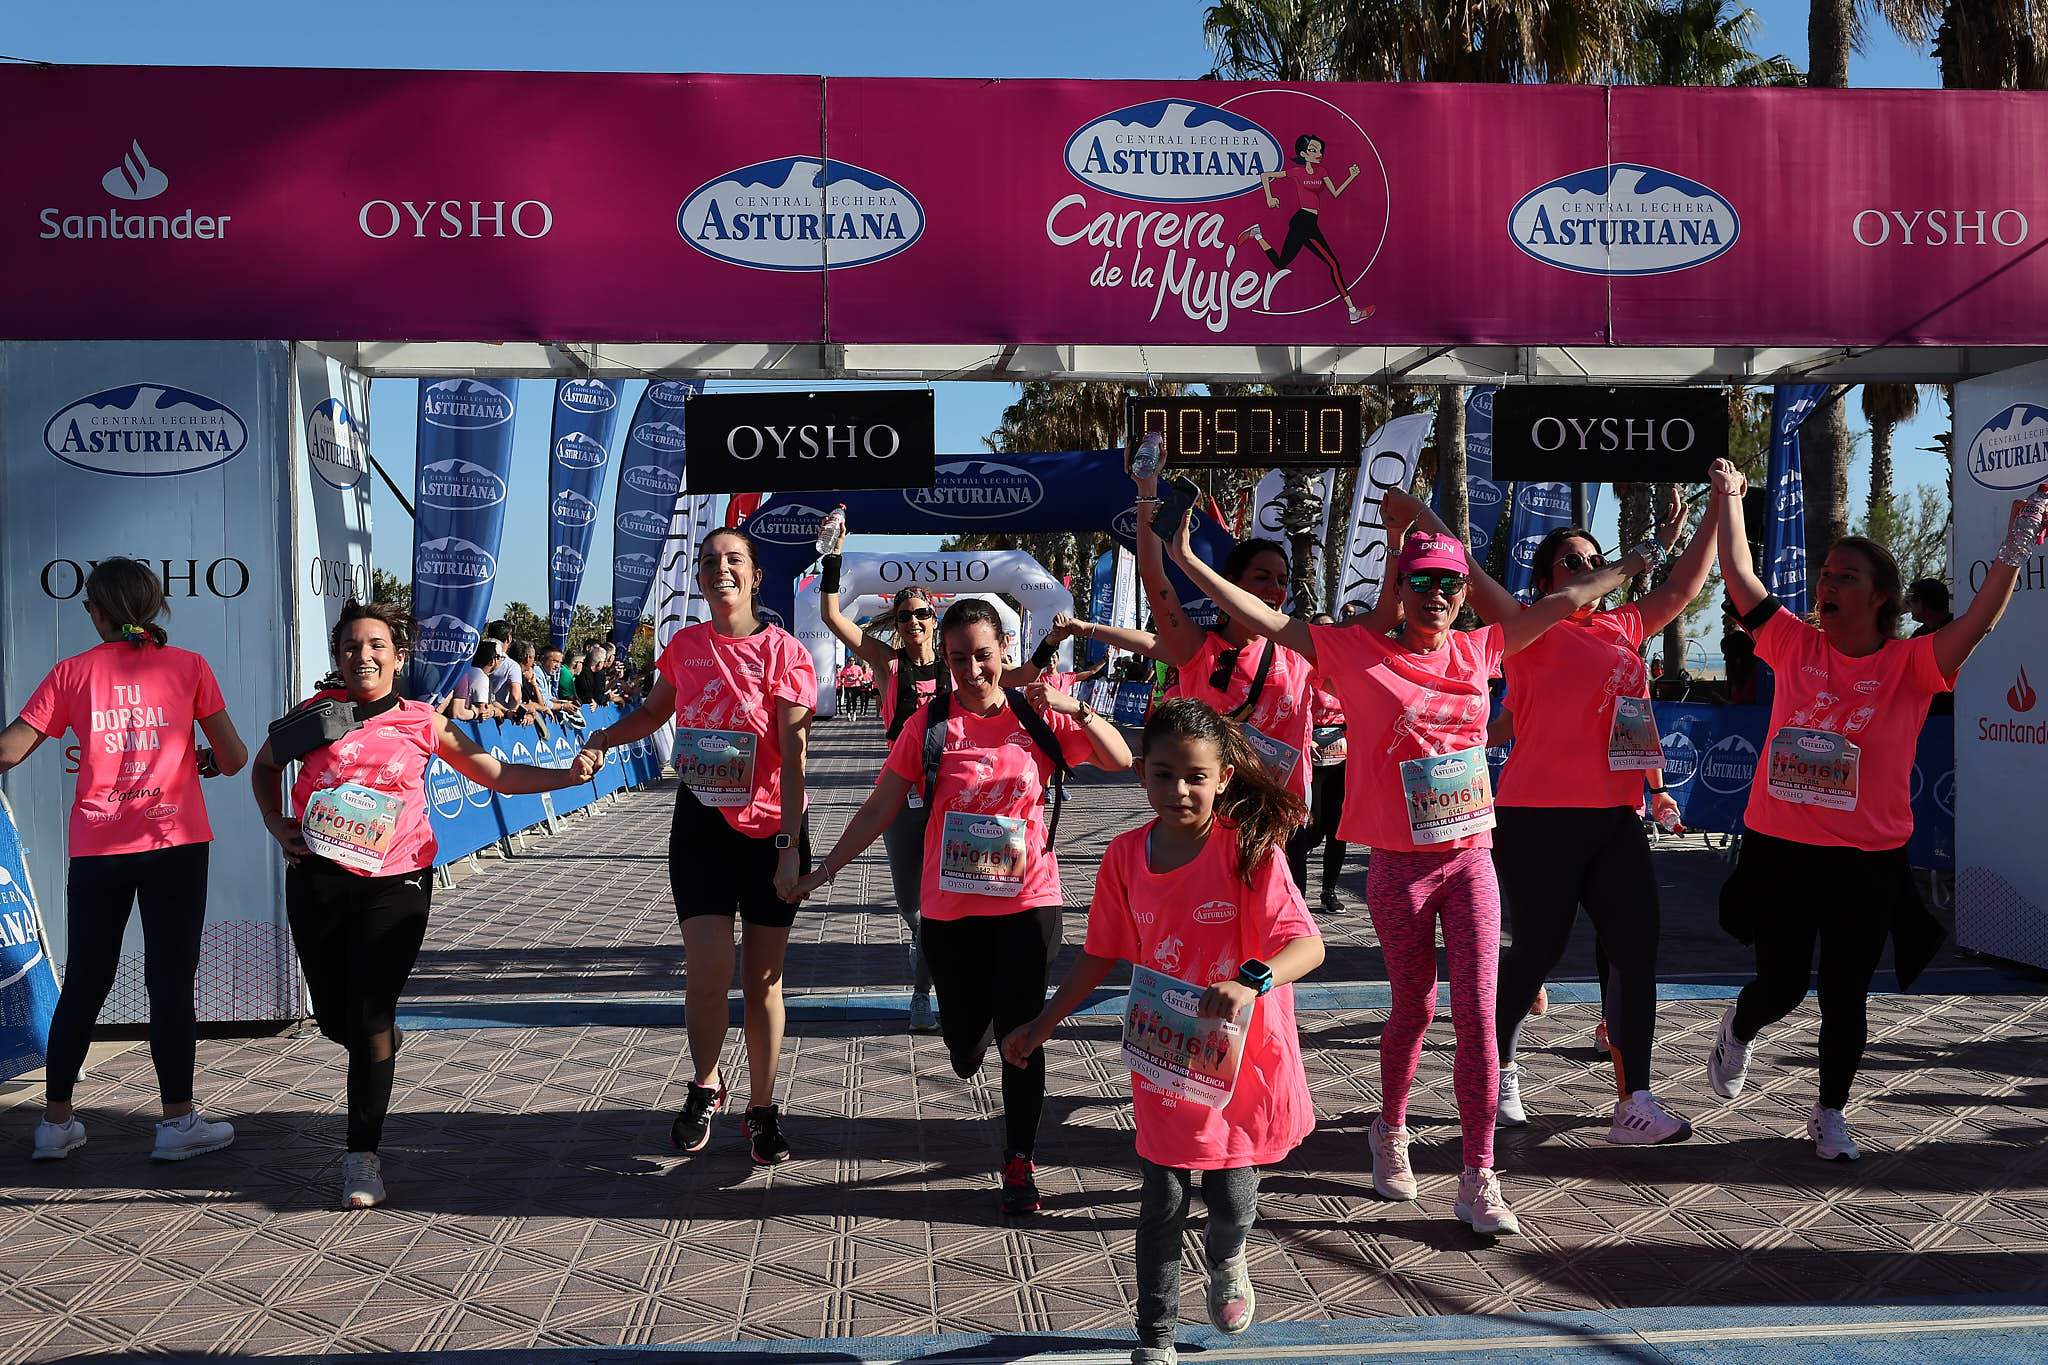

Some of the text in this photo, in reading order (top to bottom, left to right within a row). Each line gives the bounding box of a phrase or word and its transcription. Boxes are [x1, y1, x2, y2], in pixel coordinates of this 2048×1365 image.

[1115, 134, 1259, 146] CENTRAL LECHERA
[1081, 136, 1263, 176] ASTURIANA
[735, 197, 811, 207] CENTRAL
[1561, 202, 1714, 213] CENTRAL LECHERA
[39, 208, 231, 239] Santander
[358, 200, 553, 239] OYSHO
[697, 198, 907, 241] ASTURIANA
[1047, 193, 1225, 250] Carrera
[1527, 204, 1721, 246] ASTURIANA
[1852, 208, 2028, 247] OYSHO
[1089, 245, 1292, 333] de la Mujer
[425, 394, 505, 419] ASTURIANA
[563, 389, 609, 407] ASTURIANA
[91, 416, 226, 425] CENTRAL LECHERA
[59, 418, 233, 453] ASTURIANA
[726, 423, 900, 461] OYSHO
[1531, 416, 1696, 452] OYSHO
[1988, 427, 2048, 447] CENTRAL LECHE
[312, 423, 361, 472] ASTURIANA
[1974, 442, 2048, 474] ASTURIAN
[628, 470, 678, 492] ASTURIANA
[913, 486, 1034, 505] ASTURIANA
[1524, 490, 1571, 512] ASTURIA
[620, 515, 667, 536] ASTURIAN
[755, 519, 822, 536] ASTURIAN
[1421, 540, 1455, 554] DRUNI
[40, 557, 250, 600] OHO
[311, 556, 367, 601] OYSHO
[879, 559, 990, 583] OYSHO
[1020, 582, 1054, 591] OYSHO
[798, 630, 830, 639] OYSHO
[684, 658, 714, 667] OYSHO
[114, 685, 141, 706] TU
[91, 706, 169, 732] DORSAL
[1978, 716, 2048, 744] Santand
[104, 730, 161, 753] SUMA
[124, 761, 147, 773] 2024
[697, 763, 727, 777] 016
[1703, 755, 1753, 780] ASTURIANA
[1439, 788, 1471, 807] 016
[333, 815, 366, 836] 016
[1423, 828, 1452, 840] OYSHO
[331, 838, 338, 846] LA
[969, 849, 1001, 865] 016
[1195, 910, 1235, 920] ASTURIANA
[1164, 993, 1199, 1013] ASTURIA
[1158, 1026, 1201, 1056] 016
[1126, 1043, 1225, 1088] CARRERA DE LA MUJER VALENCIA
[1163, 1050, 1184, 1064] 6148
[1130, 1057, 1160, 1079] OYSHO
[1180, 1082, 1217, 1101] Santander
[1162, 1097, 1177, 1108] 2024
